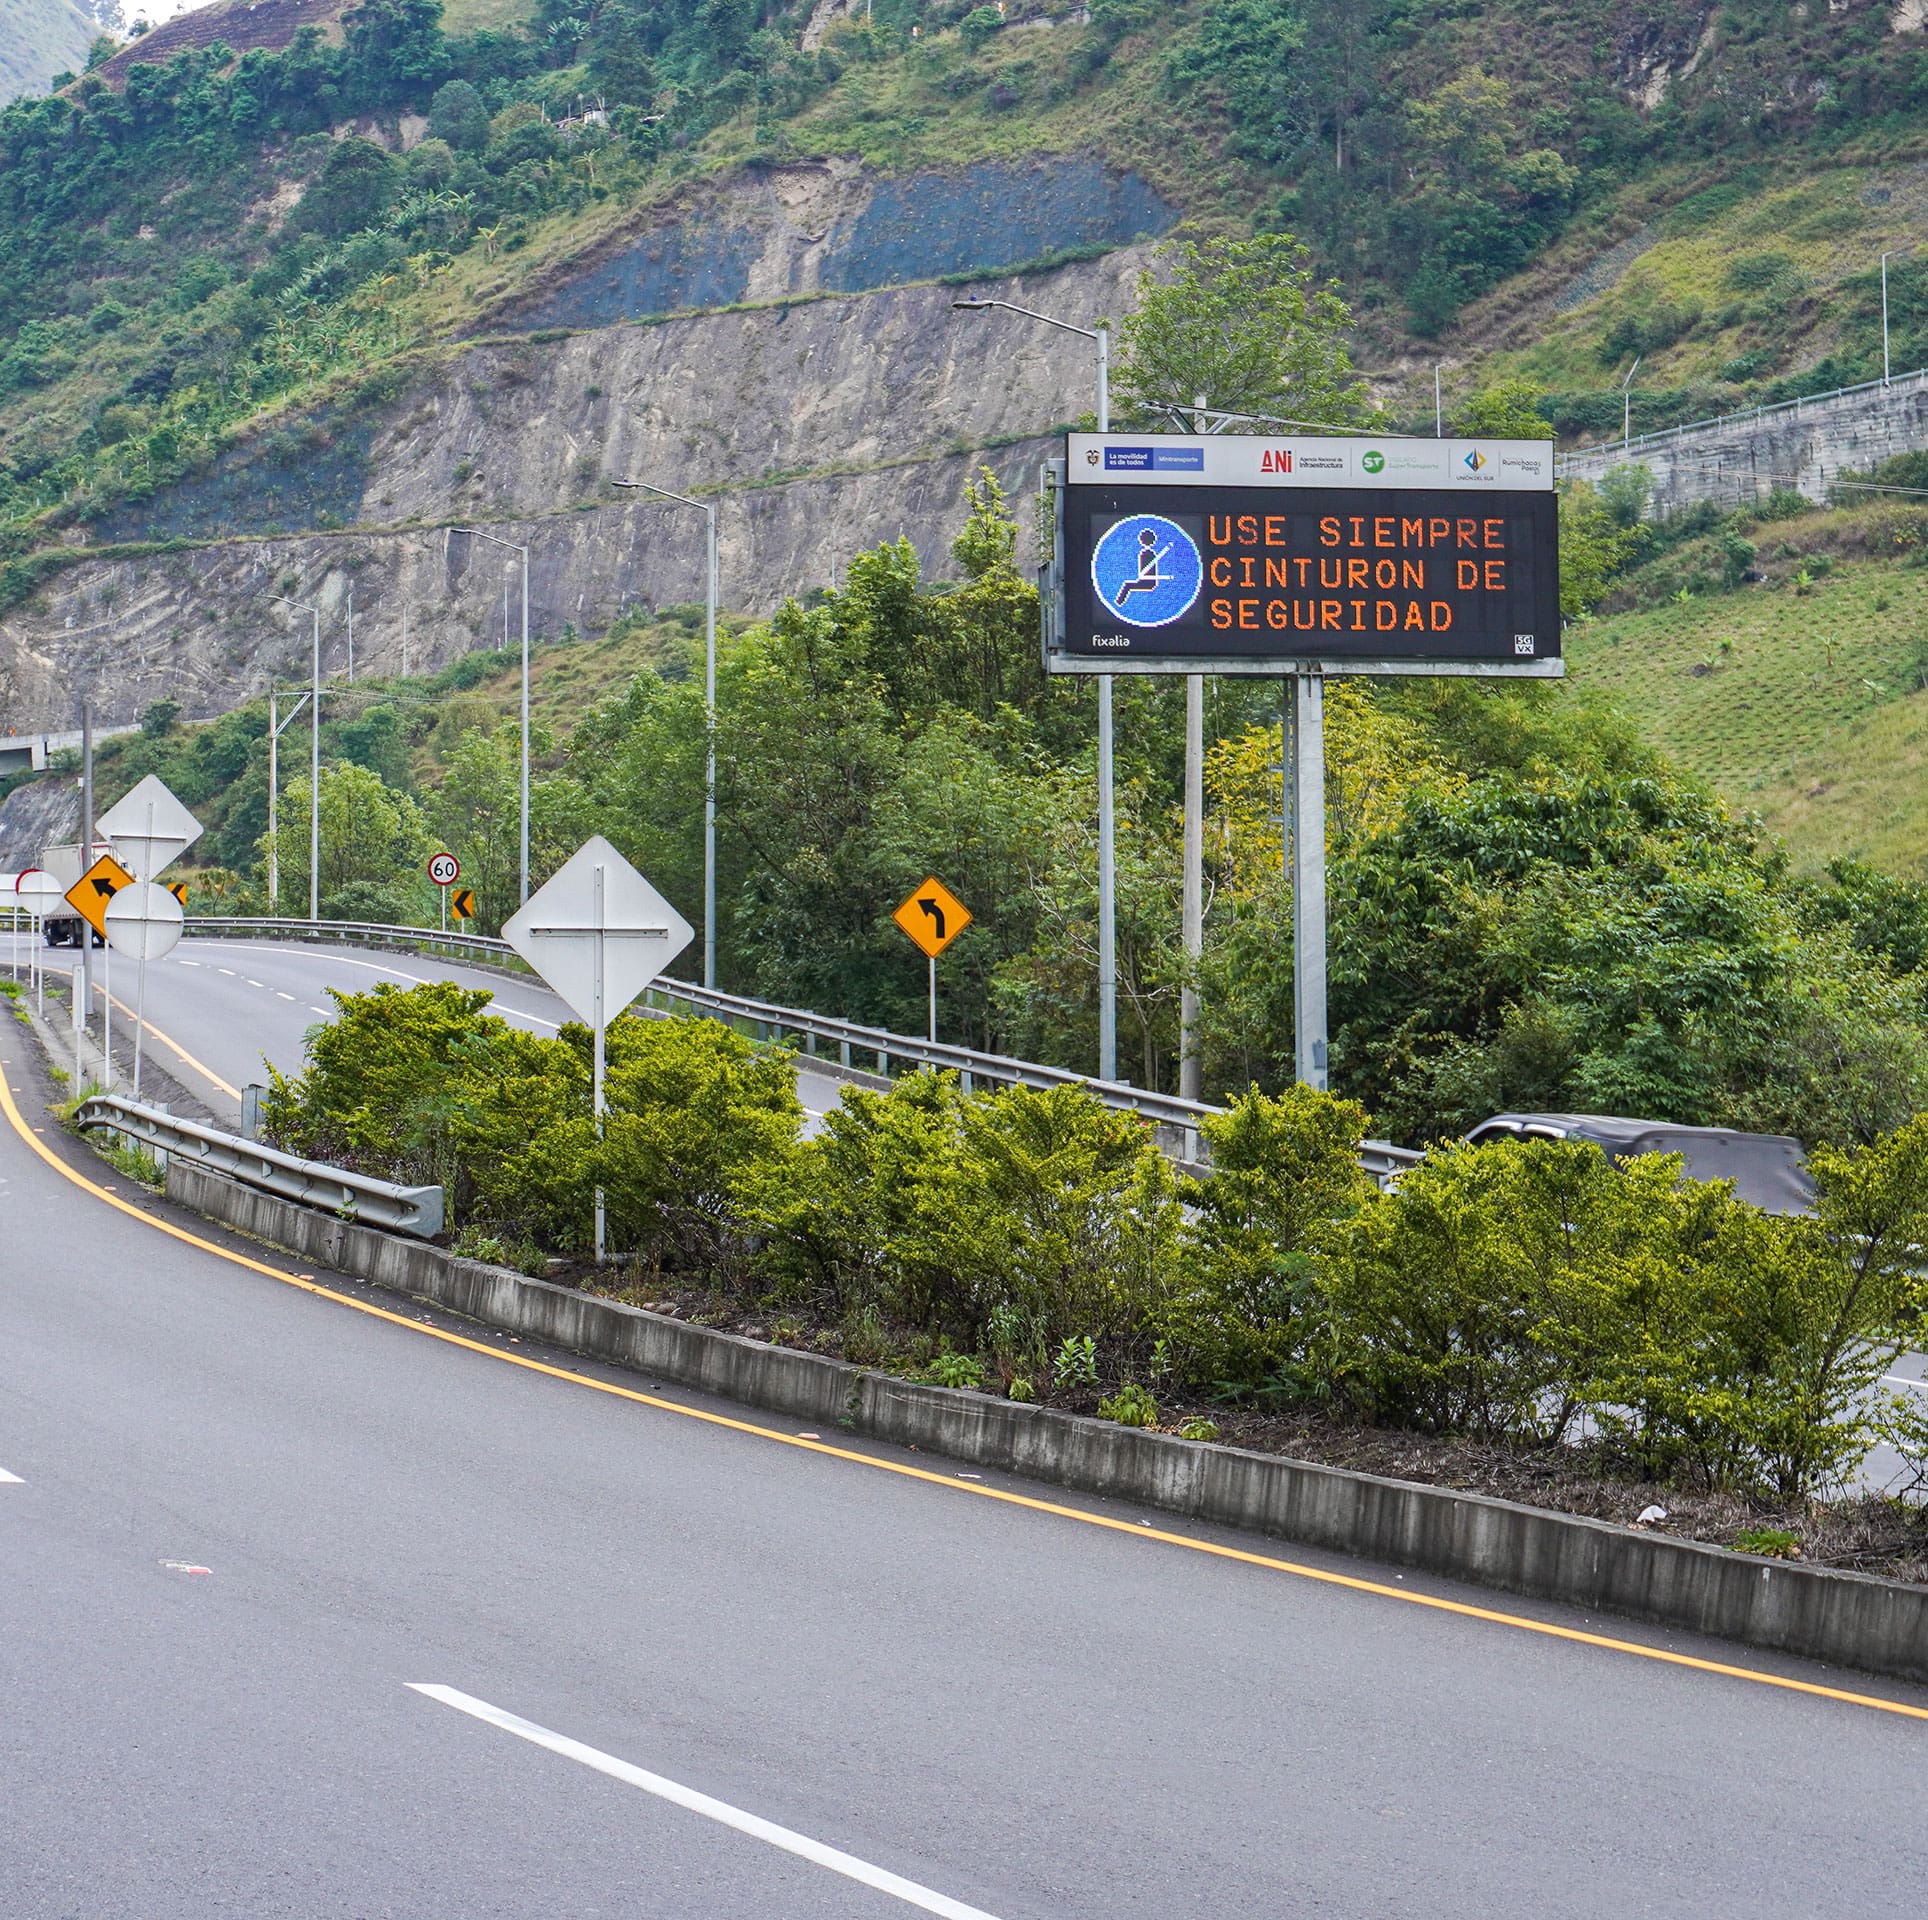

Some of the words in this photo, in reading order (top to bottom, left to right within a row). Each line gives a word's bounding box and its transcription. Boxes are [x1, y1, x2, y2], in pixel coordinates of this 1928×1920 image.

[1158, 455, 1199, 463] Mintransporte
[1364, 457, 1383, 468] ST
[1209, 515, 1286, 547] USE
[1320, 516, 1505, 549] SIEMPRE
[1210, 557, 1424, 590] CINTURON
[1457, 560, 1506, 591] DE
[1210, 599, 1452, 632] SEGURIDAD
[434, 862, 455, 876] 60
